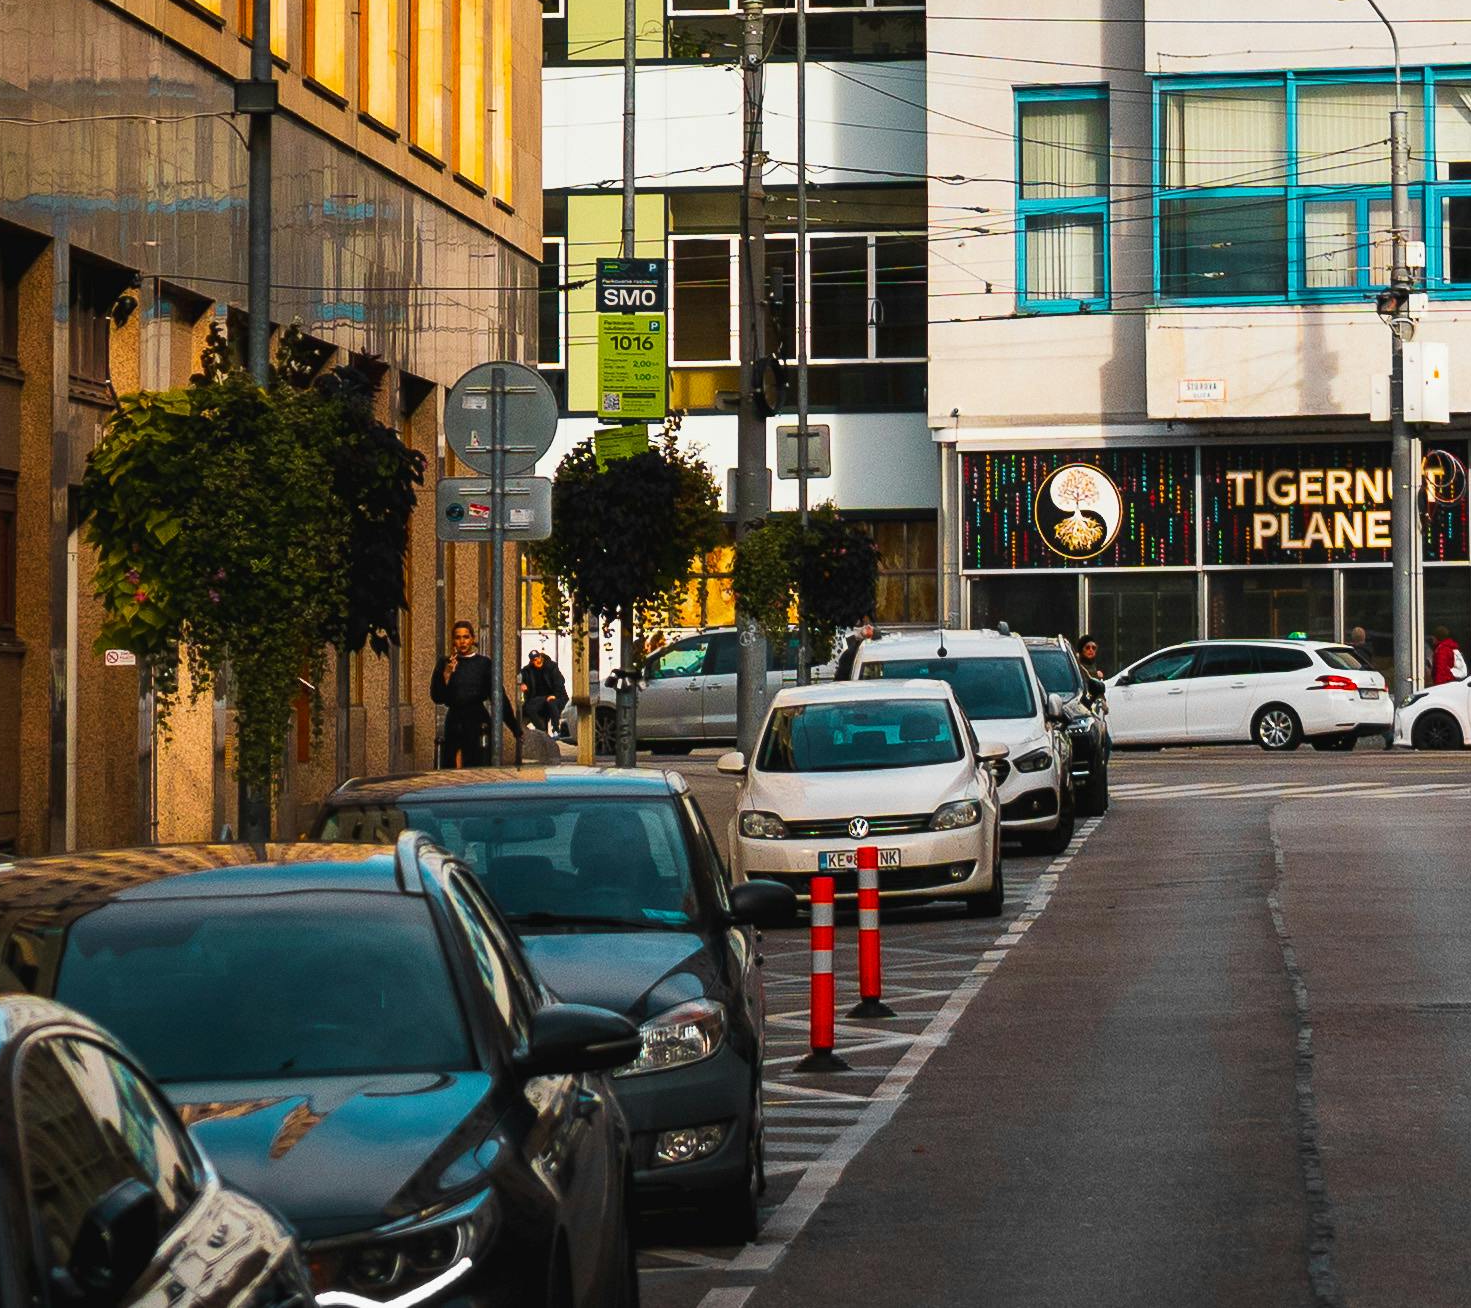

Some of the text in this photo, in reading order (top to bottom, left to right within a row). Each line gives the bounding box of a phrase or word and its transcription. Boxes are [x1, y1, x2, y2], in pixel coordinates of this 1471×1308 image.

[610, 336, 654, 351] 1016
[1225, 467, 1445, 507] TIGERNT
[1253, 510, 1393, 551] PLANE
[828, 853, 846, 867] KE
